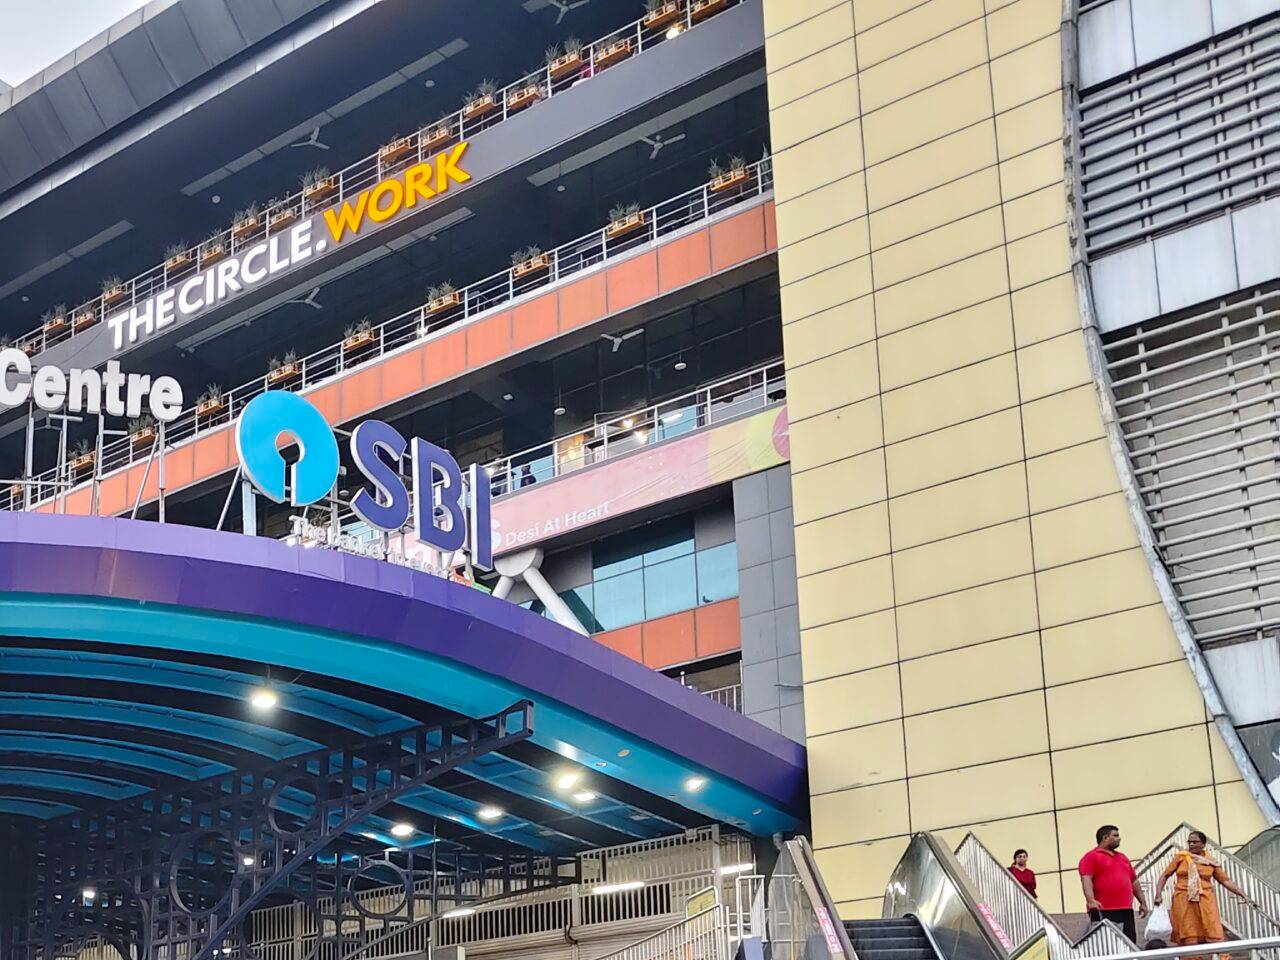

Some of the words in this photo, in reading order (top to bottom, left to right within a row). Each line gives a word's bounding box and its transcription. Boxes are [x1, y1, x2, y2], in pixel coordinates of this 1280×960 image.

[350, 419, 493, 572] SBI
[505, 523, 540, 546] Desi
[543, 518, 561, 533] At
[564, 501, 610, 528] Heart
